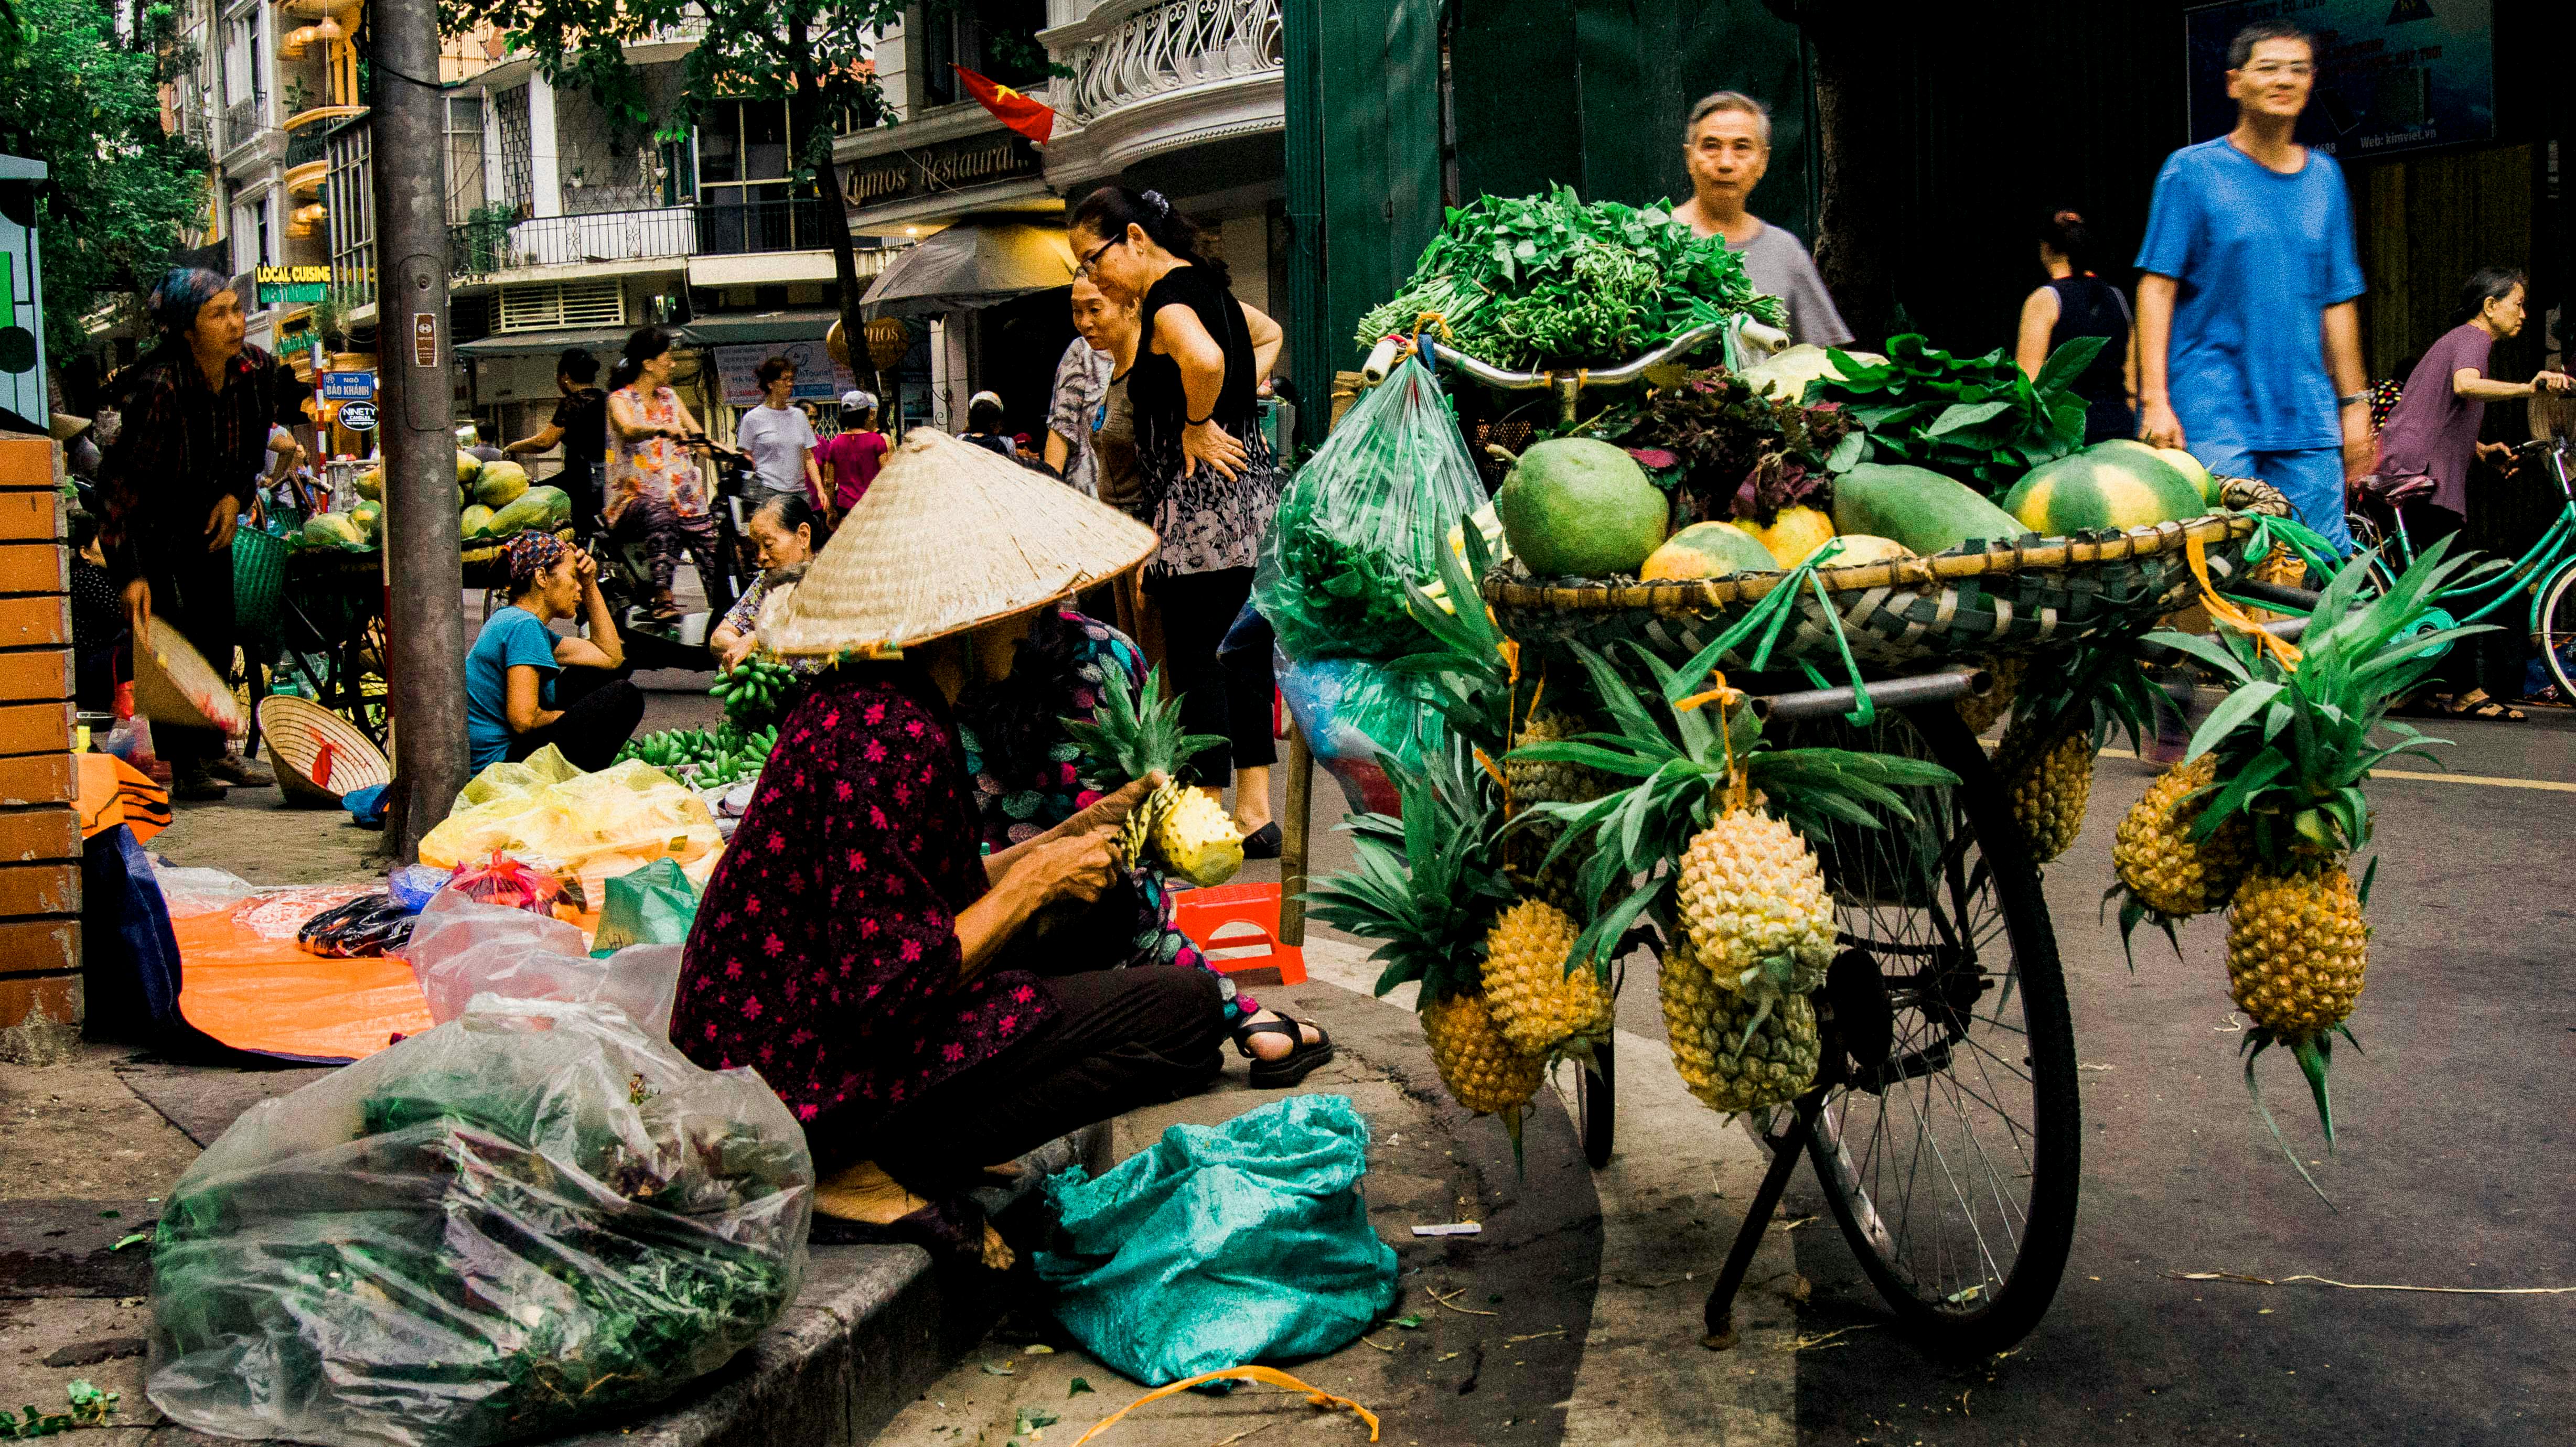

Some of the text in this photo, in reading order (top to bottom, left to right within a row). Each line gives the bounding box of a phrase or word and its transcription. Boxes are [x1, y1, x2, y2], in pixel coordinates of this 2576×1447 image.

[2360, 134, 2384, 148] Web:
[257, 267, 291, 283] LOCAL
[292, 266, 331, 282] CUISINE
[344, 384, 369, 395] KHÁNH
[342, 407, 376, 416] NINETY
